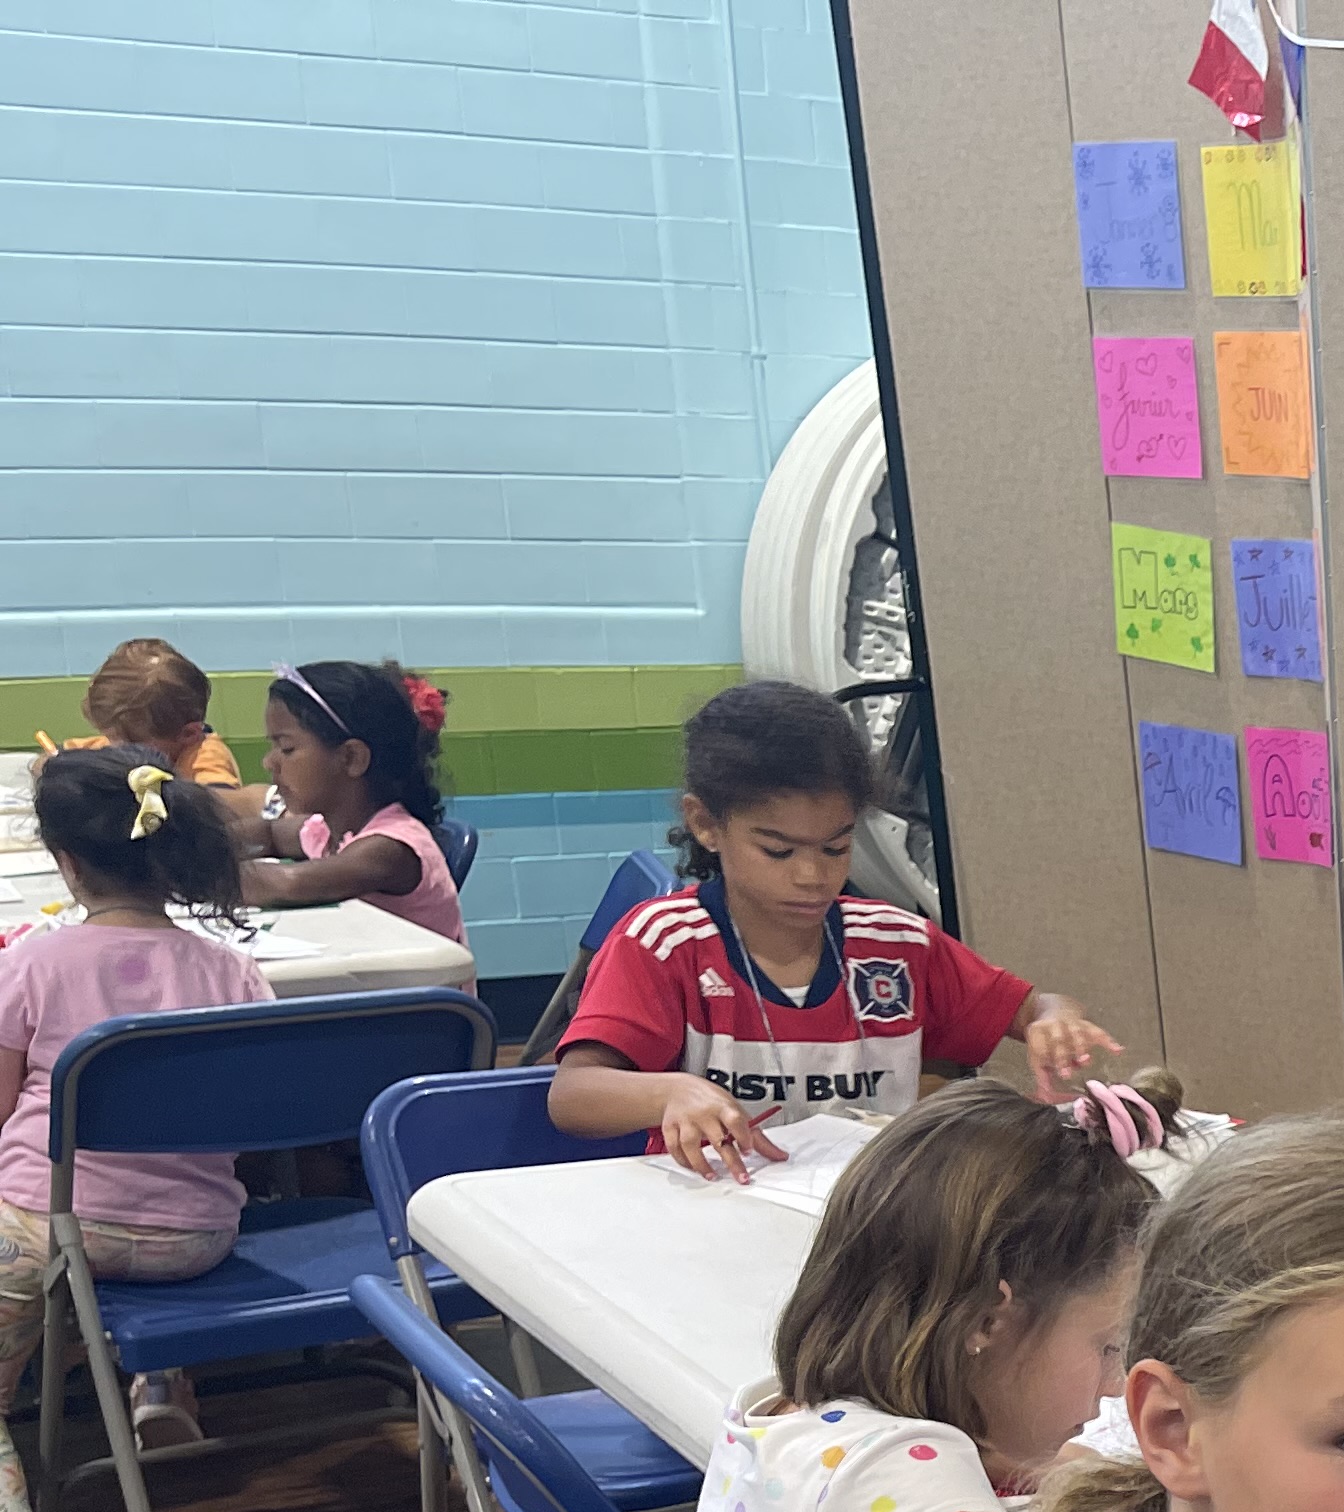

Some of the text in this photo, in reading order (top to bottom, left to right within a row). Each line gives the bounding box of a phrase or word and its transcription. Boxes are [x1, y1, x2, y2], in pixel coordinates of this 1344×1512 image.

[1118, 547, 1199, 621] Mars
[705, 1068, 886, 1102] BST BUY
